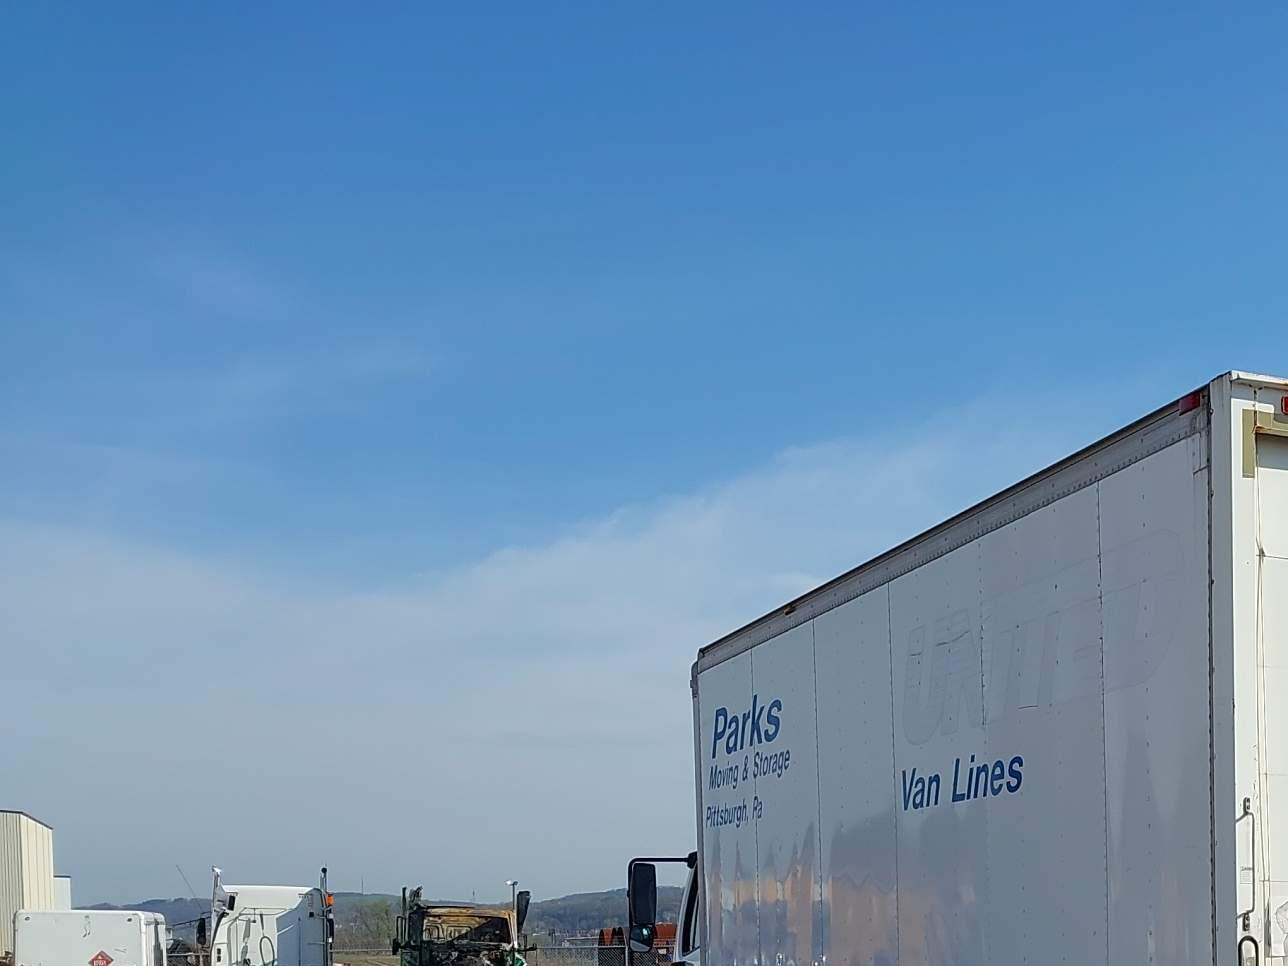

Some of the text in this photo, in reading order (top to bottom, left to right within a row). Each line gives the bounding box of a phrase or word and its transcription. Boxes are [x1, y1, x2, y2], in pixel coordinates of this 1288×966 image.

[712, 694, 782, 759] Parks
[709, 749, 790, 790] Moving & Storage
[902, 754, 1024, 811] Van Lines
[706, 796, 763, 828] Pittsburgh, Pa
